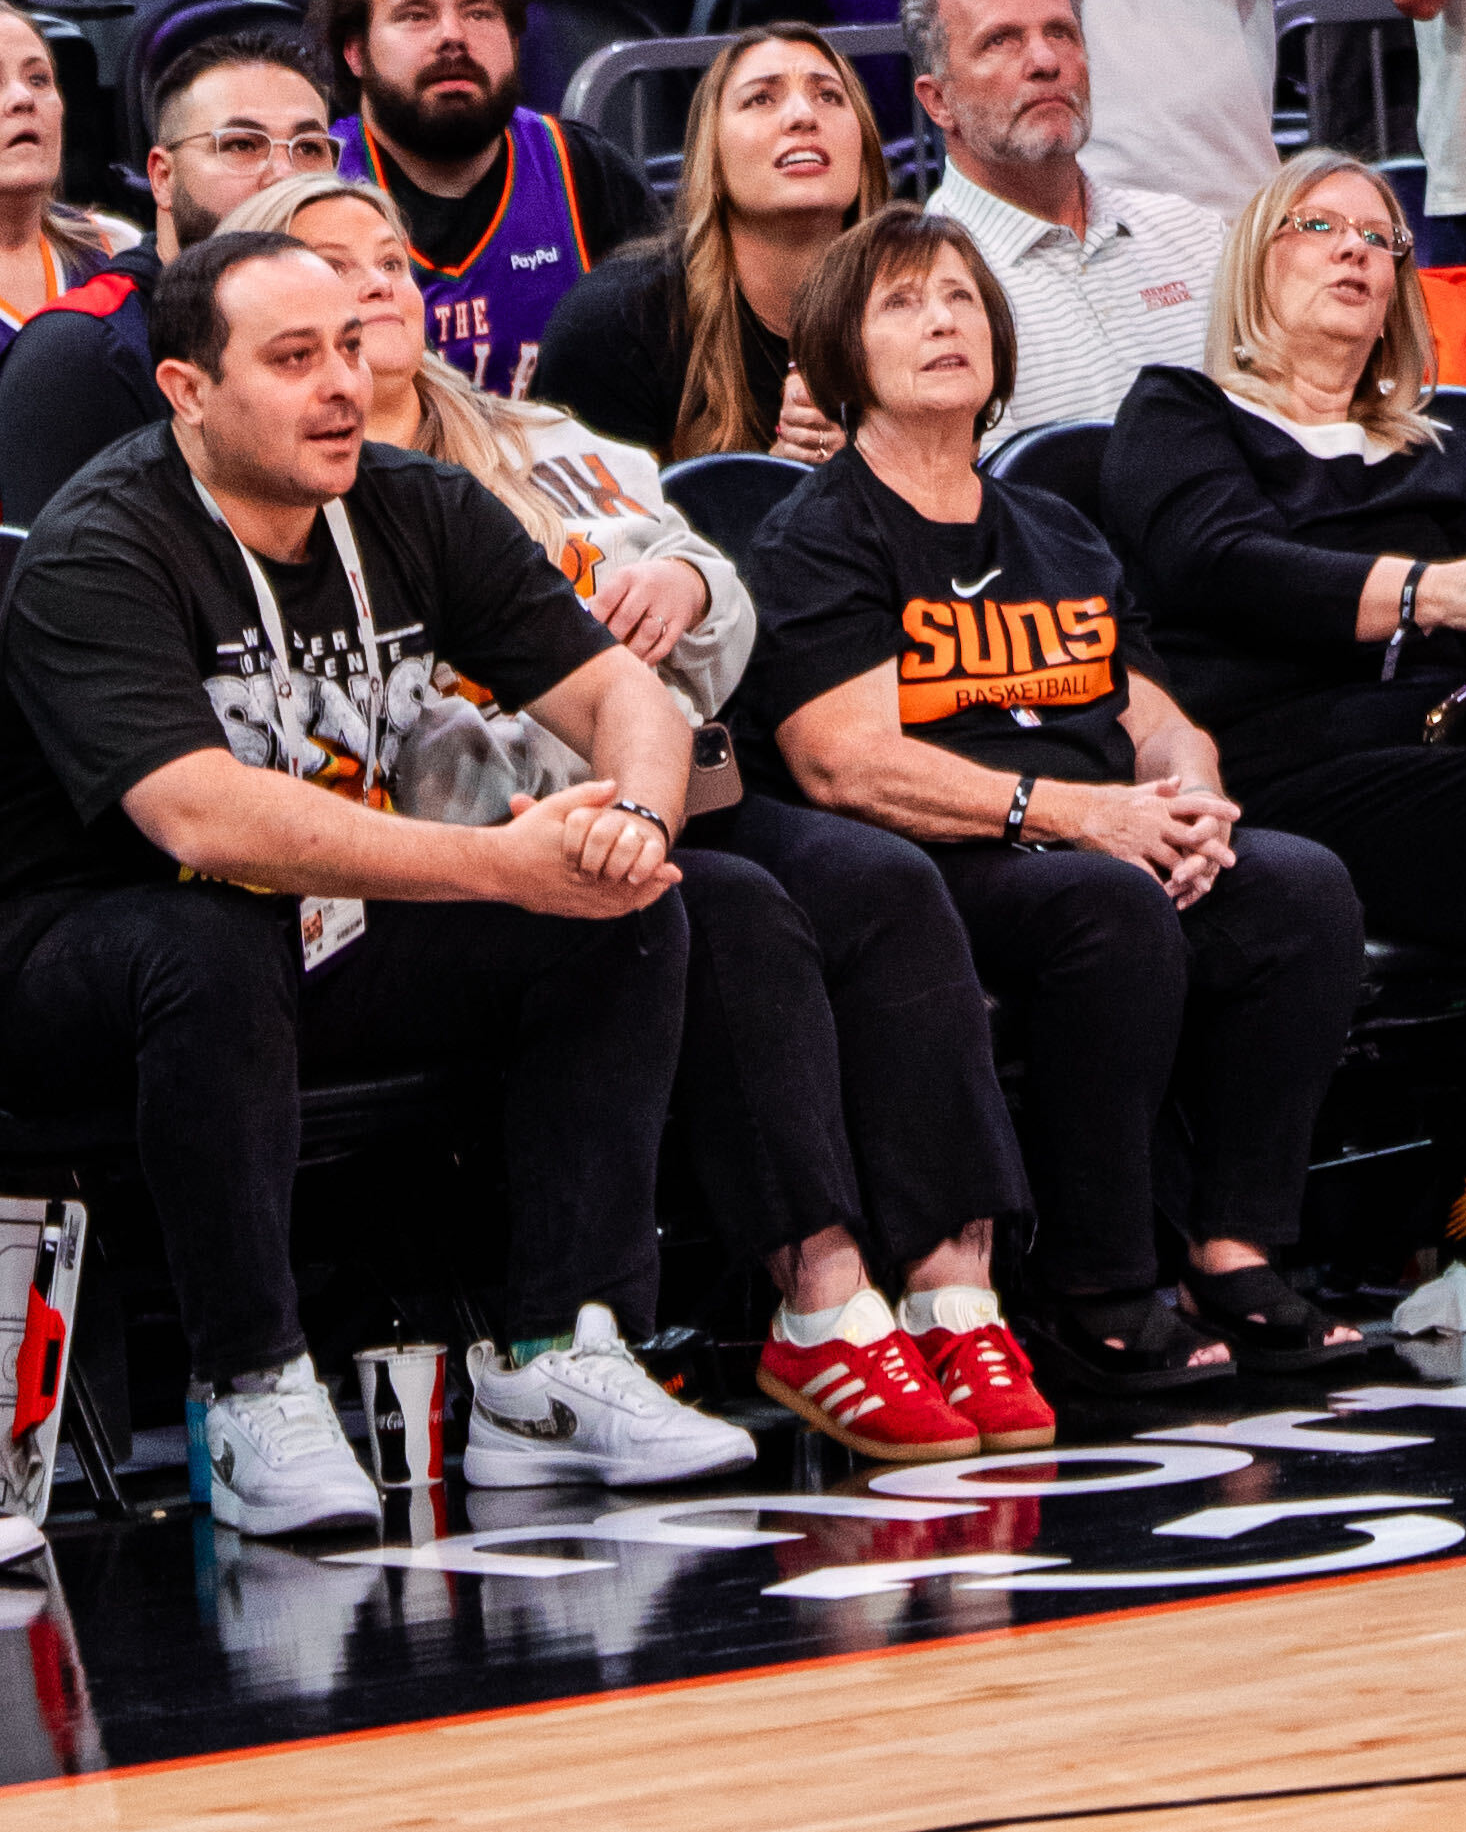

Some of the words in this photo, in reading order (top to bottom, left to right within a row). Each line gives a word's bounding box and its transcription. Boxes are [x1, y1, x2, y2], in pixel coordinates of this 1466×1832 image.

[510, 246, 561, 272] PayPal
[434, 296, 491, 344] THE
[899, 595, 1118, 681] SUNS
[955, 672, 1091, 710] BASKETBALL
